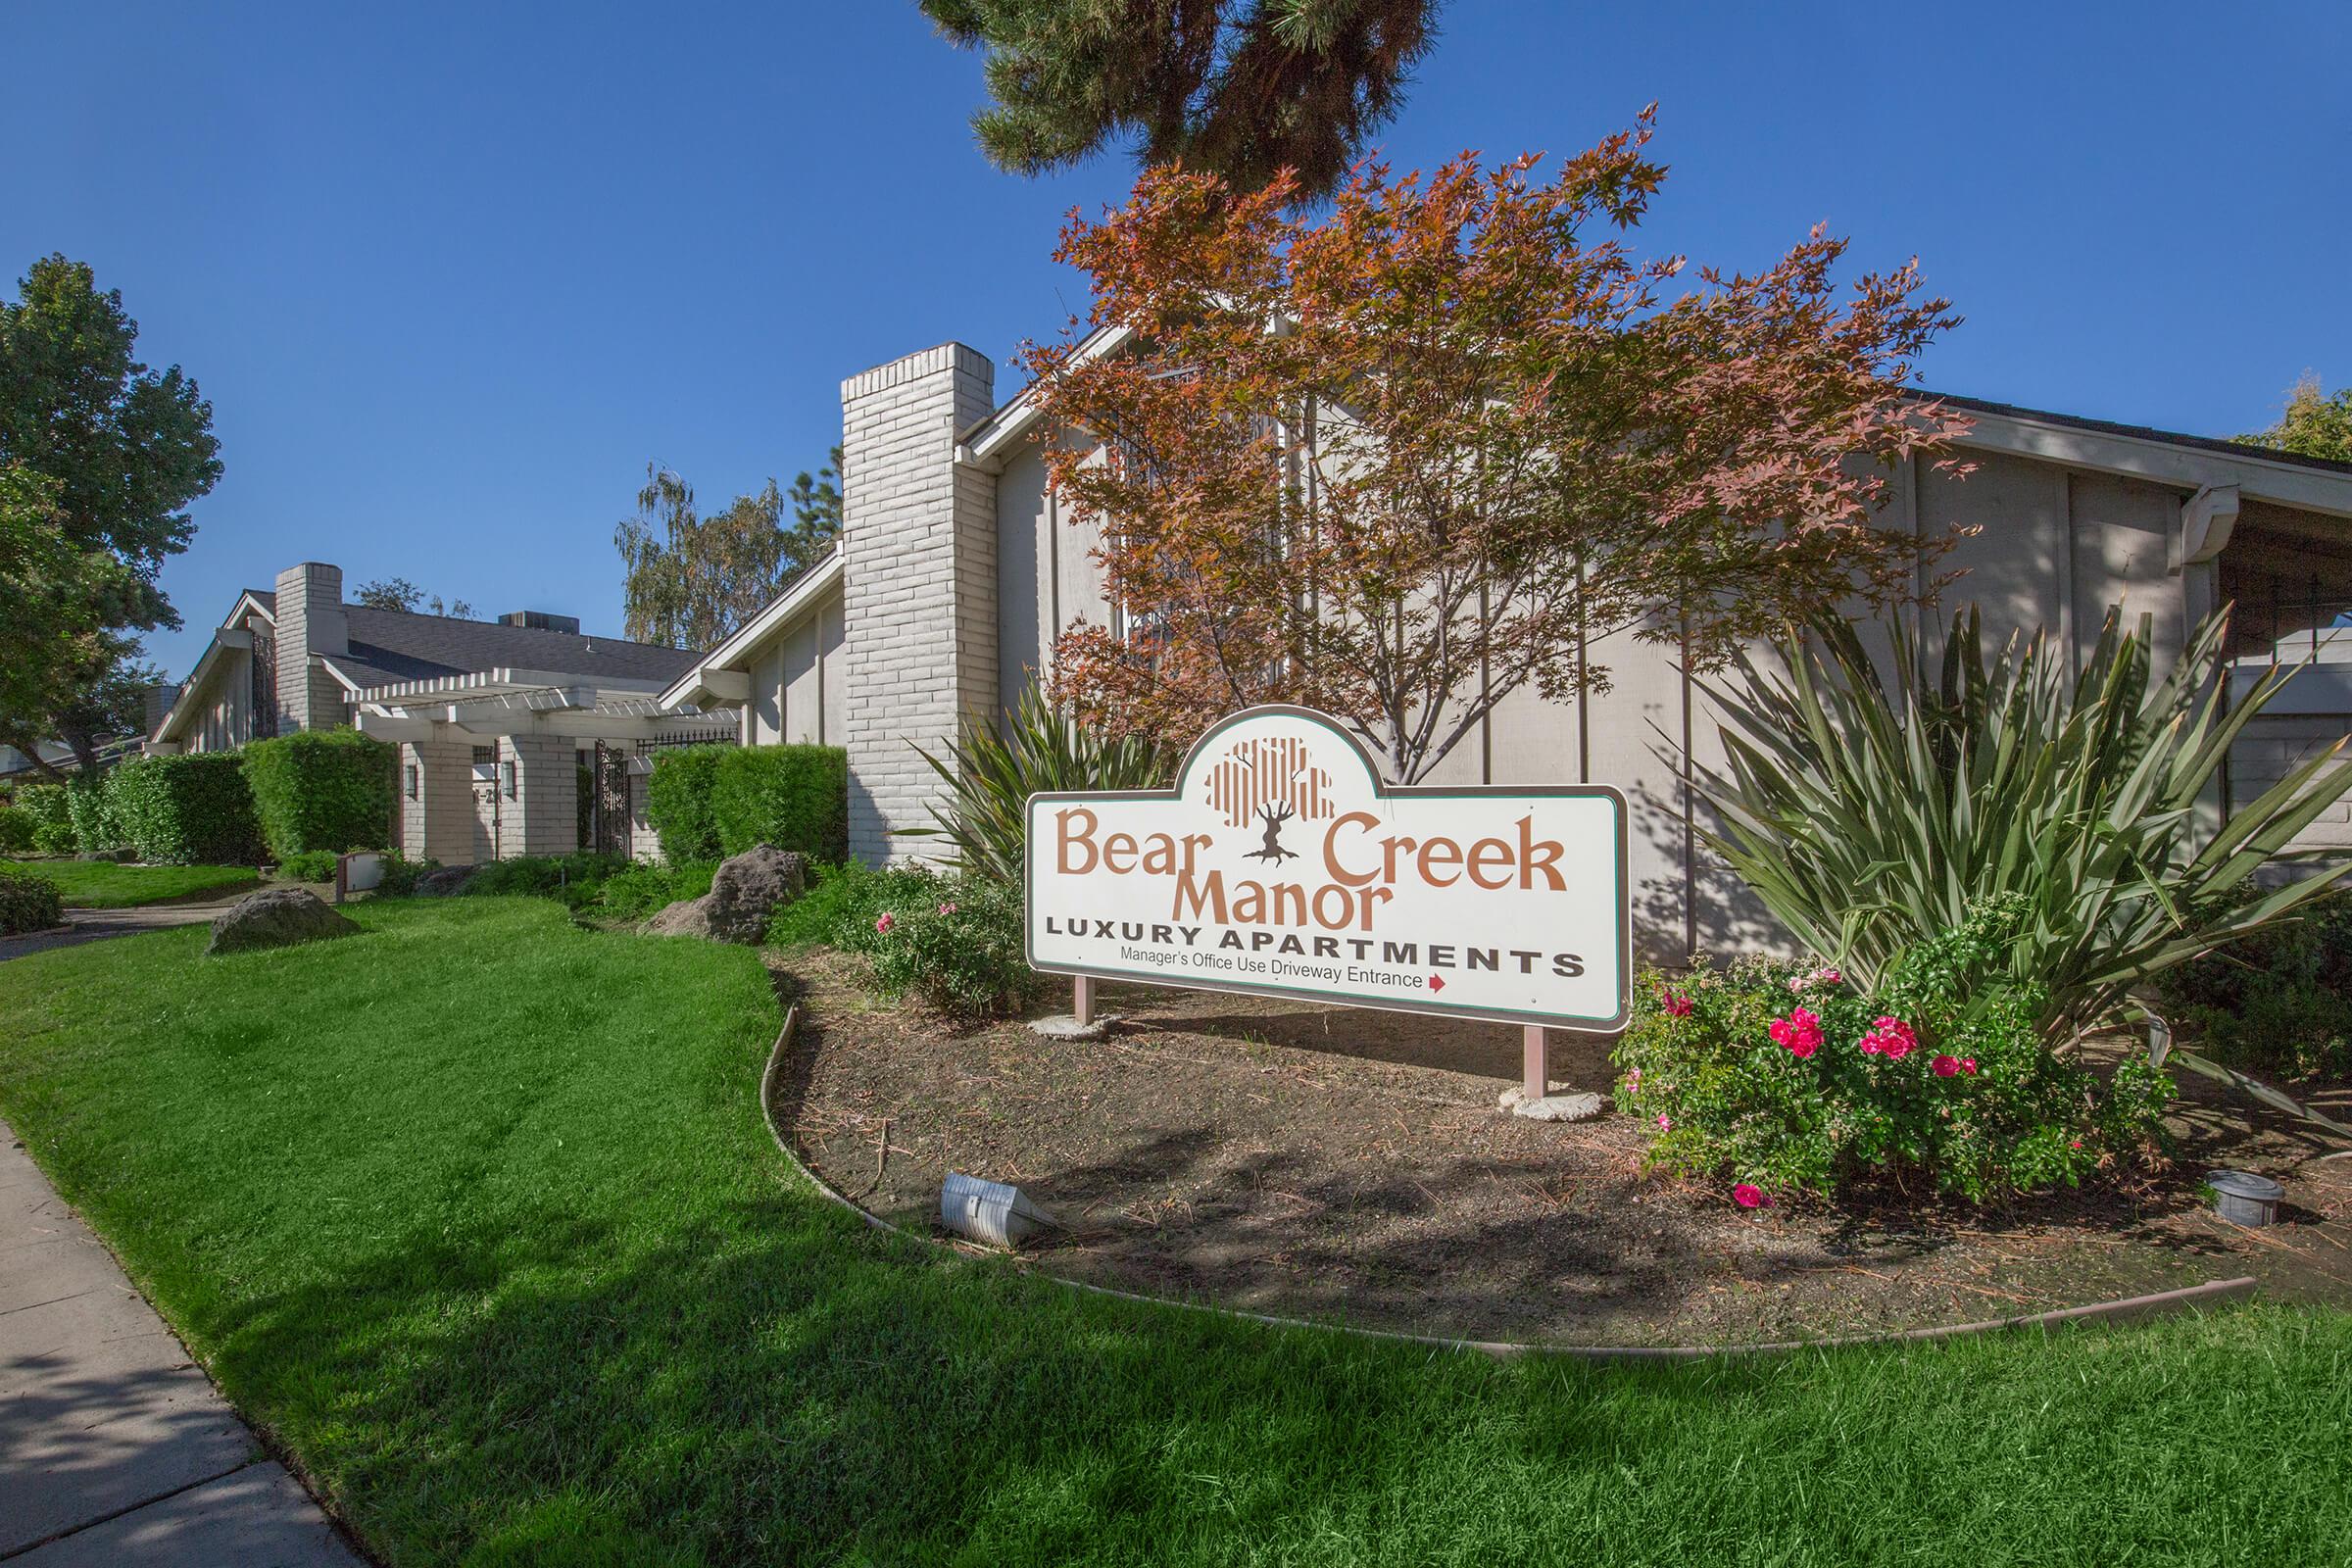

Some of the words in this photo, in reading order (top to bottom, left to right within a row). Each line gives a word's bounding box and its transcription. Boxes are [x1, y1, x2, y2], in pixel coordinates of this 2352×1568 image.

[1054, 808, 1213, 876] Bear
[1323, 811, 1567, 892] Creek
[1172, 868, 1394, 932] Manor
[1046, 916, 1202, 947] LUXURY
[1218, 929, 1585, 978] APARTMENTS
[1192, 952, 1233, 970] Office
[1237, 956, 1266, 973] Use
[1271, 959, 1343, 984] Driveway
[1348, 965, 1423, 989] Entrance
